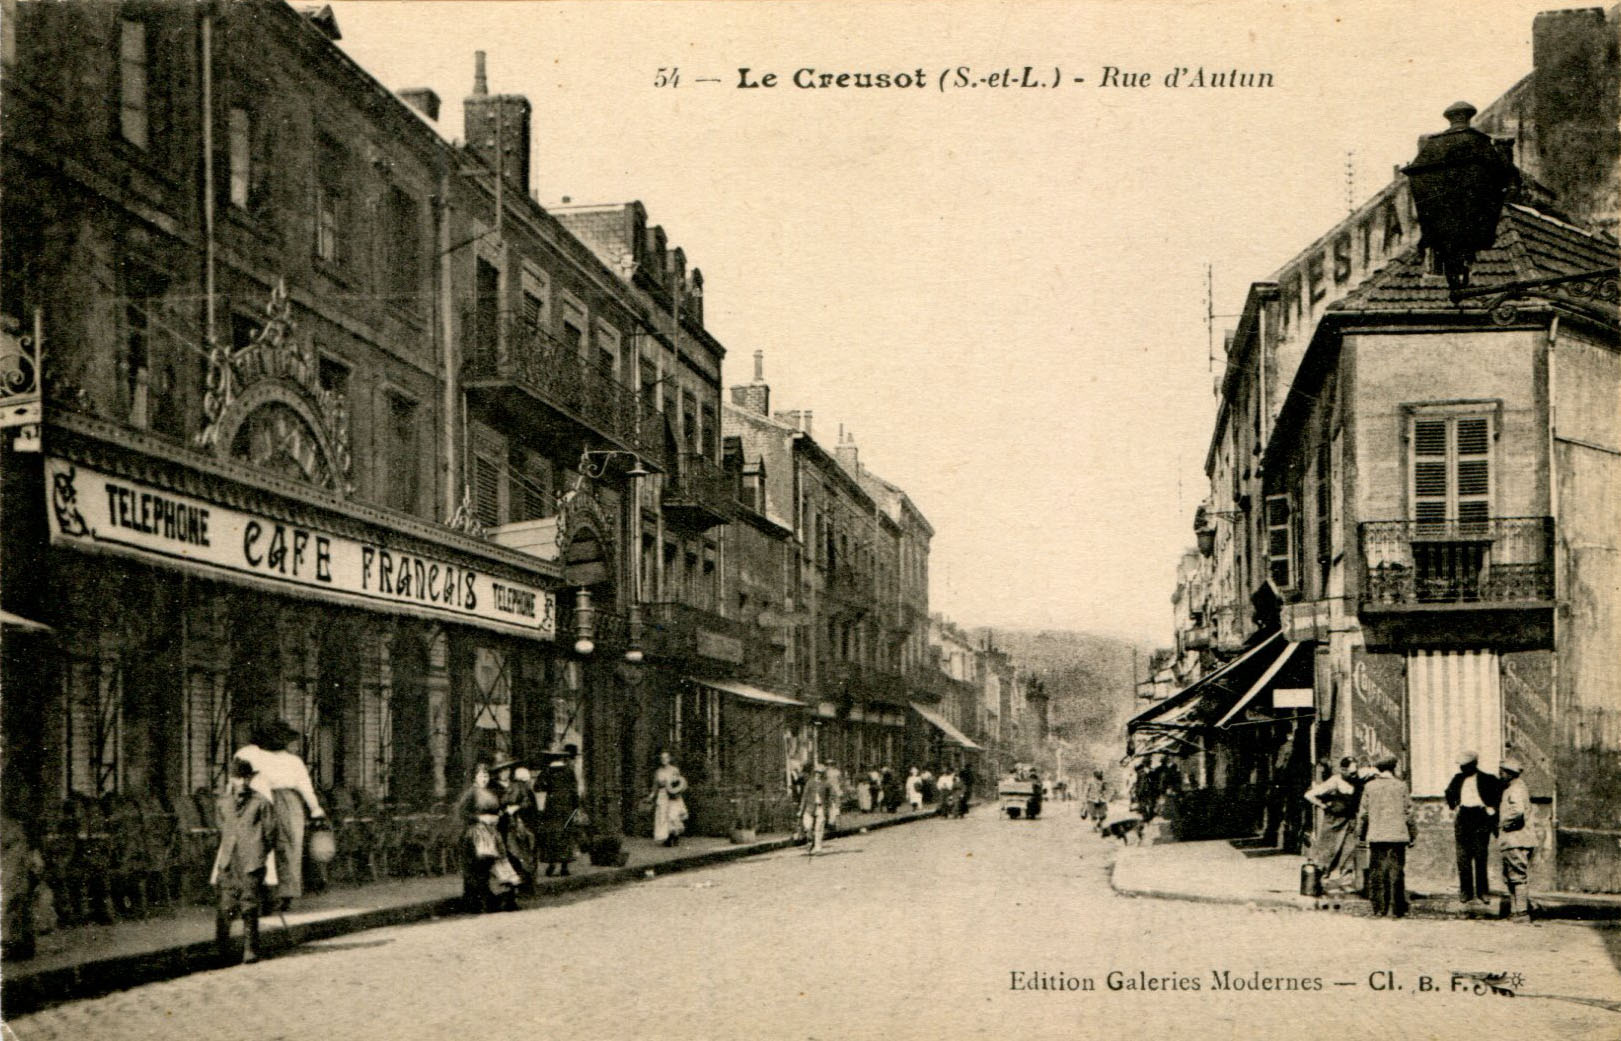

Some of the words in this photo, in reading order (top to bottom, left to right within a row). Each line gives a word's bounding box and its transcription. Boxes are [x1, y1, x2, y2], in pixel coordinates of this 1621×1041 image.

[1280, 188, 1418, 322] RESTA
[105, 483, 210, 548] TELEPHONE
[244, 520, 332, 583] CAFE
[492, 582, 536, 619] TELEPHONE
